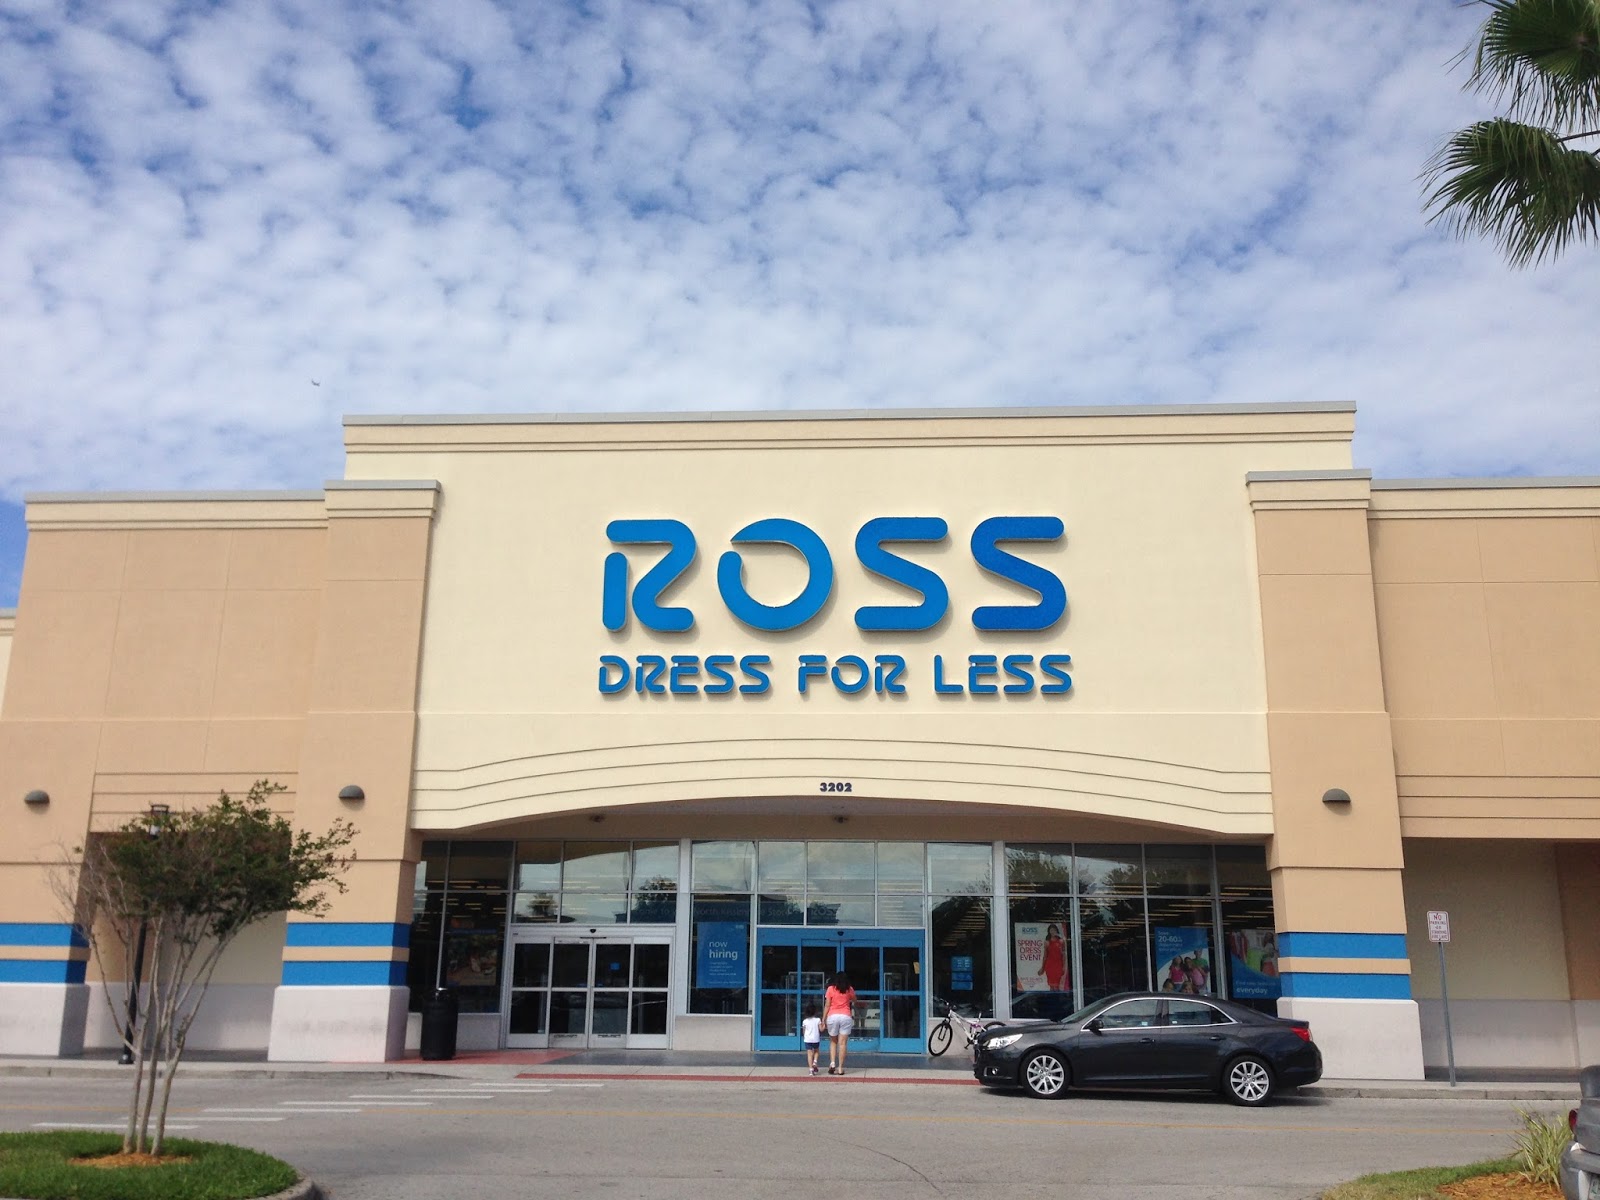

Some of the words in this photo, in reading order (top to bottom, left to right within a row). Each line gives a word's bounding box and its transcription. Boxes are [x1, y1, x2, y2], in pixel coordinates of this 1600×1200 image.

[602, 516, 1067, 632] ROSS
[599, 655, 771, 694] DRESS
[798, 655, 907, 694] FOR
[934, 655, 1074, 694] LESS
[819, 782, 853, 794] 3202
[1017, 939, 1043, 947] SPRING
[708, 949, 738, 961] hiring
[1236, 987, 1268, 995] everyday
